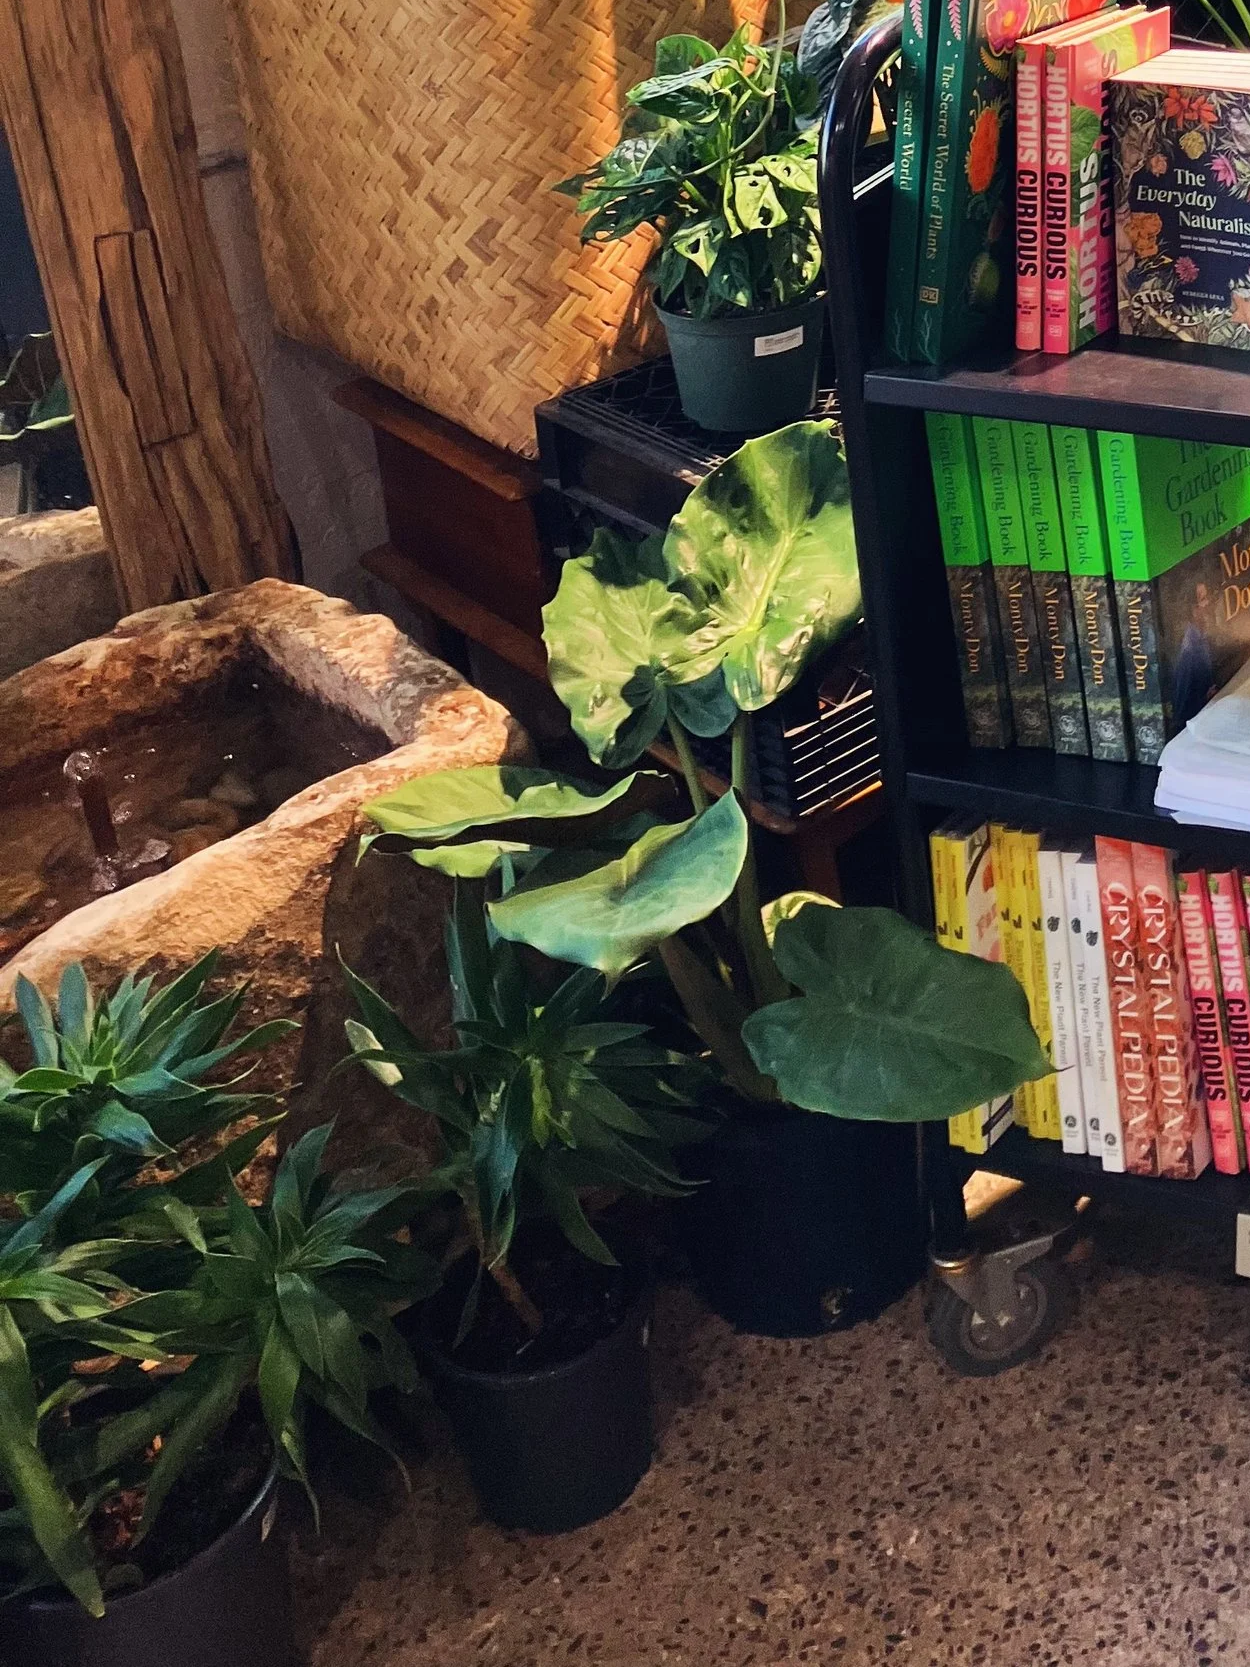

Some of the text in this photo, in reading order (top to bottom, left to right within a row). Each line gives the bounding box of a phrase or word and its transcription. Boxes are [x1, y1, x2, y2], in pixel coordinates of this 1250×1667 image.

[1017, 64, 1038, 163] HORTUS
[1047, 63, 1067, 166] HORTUS
[900, 142, 914, 191] World
[926, 63, 955, 260] The Secret World of Plants
[1136, 185, 1217, 211] Everyday
[1174, 168, 1206, 187] The
[1017, 170, 1038, 277] CURIOUS
[1046, 172, 1067, 280] CURIOUS
[1080, 152, 1098, 329] HORTUS
[950, 515, 967, 556] Book
[998, 516, 1016, 556] Book
[1024, 431, 1052, 561] Gardening Book
[1064, 435, 1092, 564] Gardening Book
[1109, 439, 1136, 570] Gardening Book
[1180, 493, 1227, 547] Book
[960, 582, 981, 673] Monty Don
[1008, 582, 1030, 673] Monty Don
[1045, 588, 1066, 680] Monty Don
[1084, 591, 1106, 685] Monty Don
[1127, 597, 1148, 690] Monty Don
[1076, 963, 1085, 980] The
[1091, 977, 1099, 994] The
[1179, 894, 1211, 991] HORTUS
[1211, 894, 1243, 992] HORTUS
[1052, 962, 1067, 1064] The New Plant Parent
[1078, 983, 1086, 1007] New
[1081, 1008, 1089, 1034] Plant
[1093, 997, 1101, 1021] New
[1106, 882, 1148, 1127] CRYSTALPEDIA
[1139, 884, 1184, 1129] CRYSTALPEDIA
[1194, 997, 1226, 1102] CURIOUS
